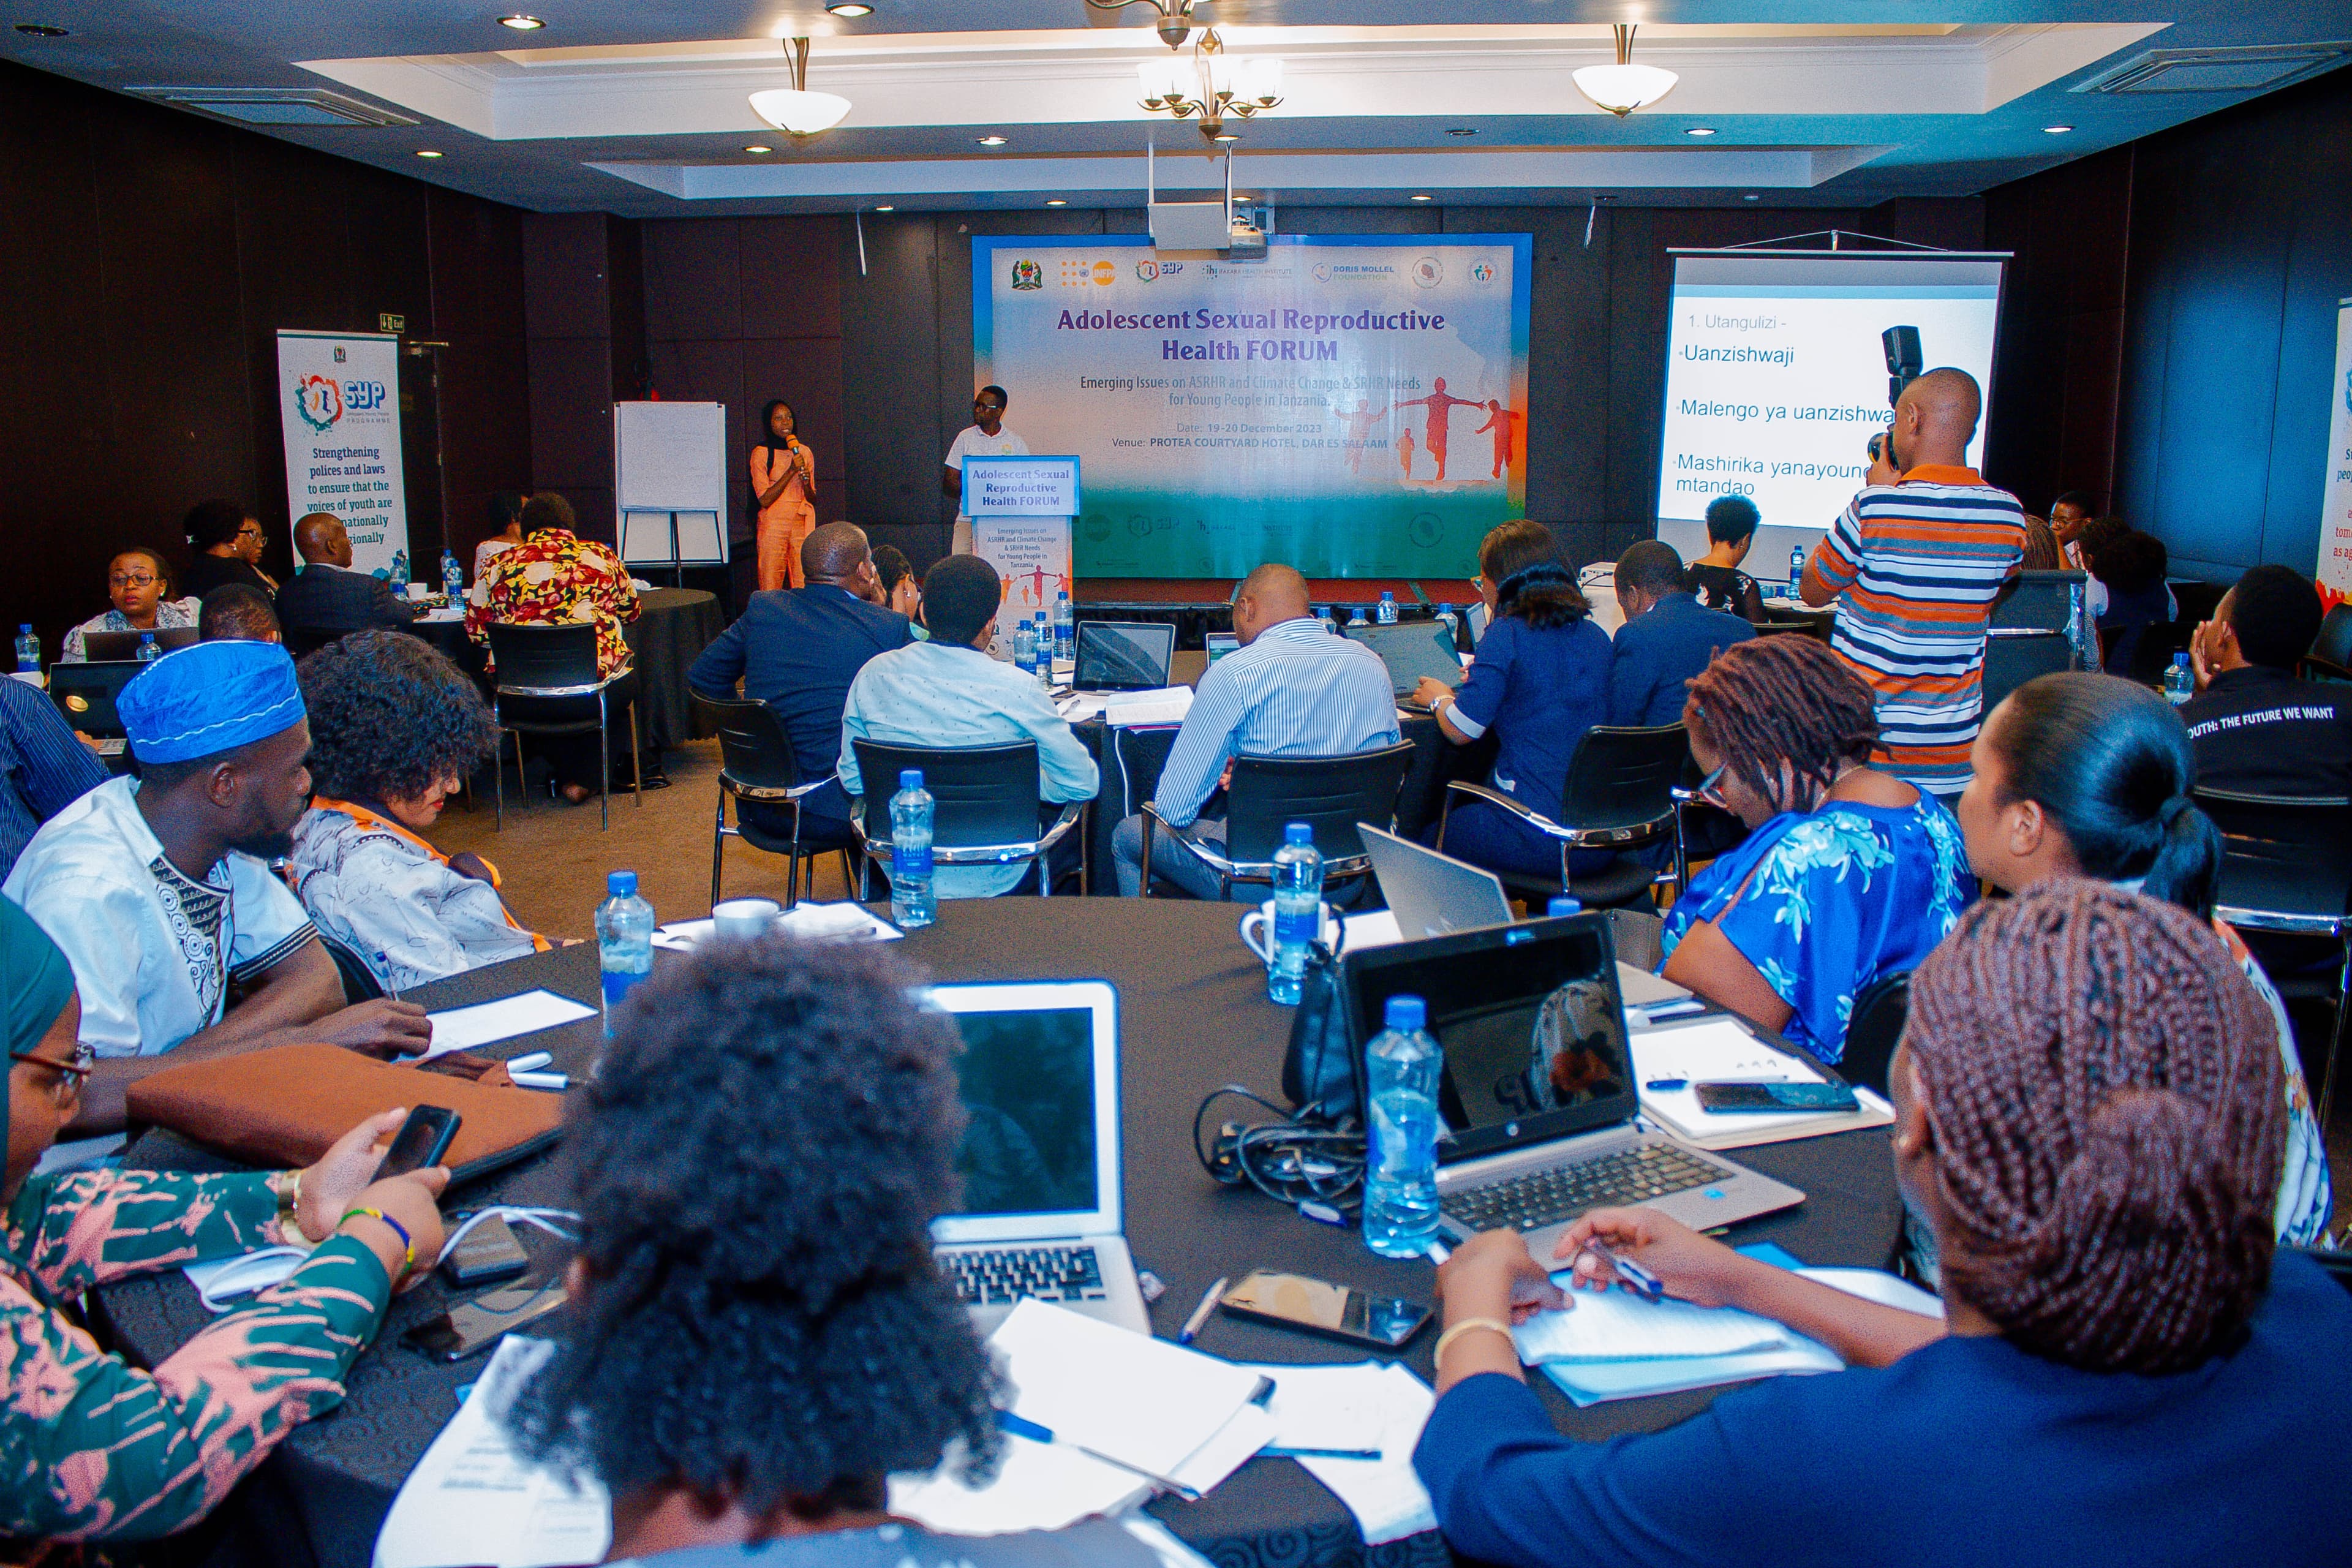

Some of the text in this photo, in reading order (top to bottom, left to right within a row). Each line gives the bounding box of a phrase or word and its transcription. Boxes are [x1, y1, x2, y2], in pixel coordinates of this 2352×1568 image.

[1161, 262, 1183, 274] SYP
[1057, 308, 1445, 334] Adolescent Sexual Reproductive
[1689, 314, 1700, 327] 1.
[1705, 314, 1777, 332] Utangulizi
[1162, 339, 1338, 361] Health FORUM
[1685, 344, 1794, 368] Uanzishwaji
[1080, 375, 1420, 392] Emerging Issues on ASRHR and Climate Change & SRHR Needs
[343, 380, 386, 409] SYP
[1169, 393, 1331, 409] for Young People in Tanzania.
[1681, 399, 1896, 423] Malengo ya uanzishwa
[1177, 423, 1322, 433] Date: 19-20 December 2023
[1112, 437, 1388, 449] Venue: PROTEA COURTYARD HOTEL, DAR ES SALAAM
[312, 446, 380, 461] Strengthening
[309, 464, 386, 479] polices and laws
[1677, 454, 1764, 473] Mashirika
[973, 469, 1069, 479] Adolescent Sexual
[307, 481, 390, 494] to ensure that the
[986, 483, 1057, 494] Reproductive
[1676, 477, 1755, 495] mtandao
[307, 497, 393, 513] voices of youth are
[982, 497, 1060, 506] Health FORUM
[2220, 715, 2241, 729] THE
[2242, 708, 2283, 725] FUTURE
[2282, 707, 2301, 720] WE
[2301, 706, 2334, 720] WANT
